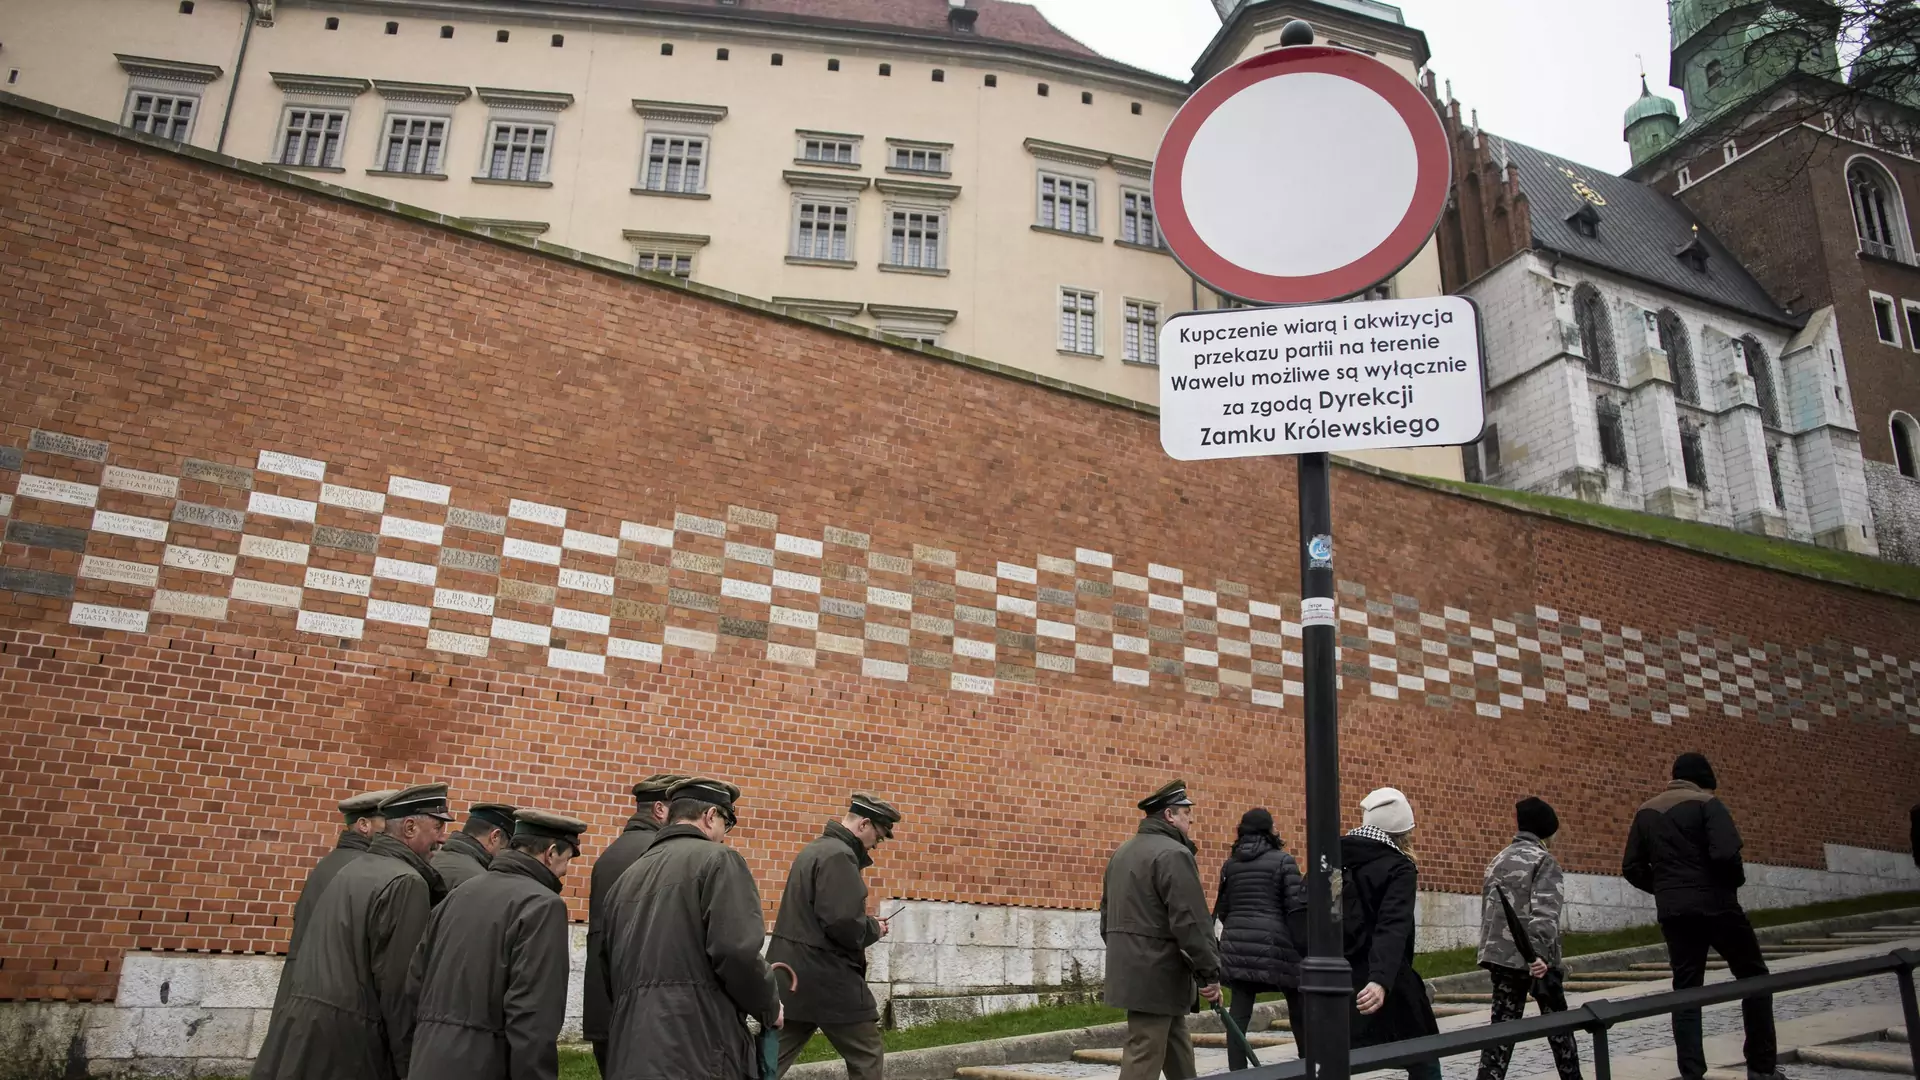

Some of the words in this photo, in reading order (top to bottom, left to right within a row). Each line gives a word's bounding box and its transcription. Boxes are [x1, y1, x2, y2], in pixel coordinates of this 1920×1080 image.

[1180, 321, 1278, 345] Kupczenie
[1284, 318, 1337, 335] wiarą
[1343, 315, 1348, 331] i
[1354, 308, 1453, 330] akwizycja
[1194, 347, 1278, 369] przekazu
[1285, 340, 1333, 363] partii
[1340, 341, 1364, 355] na
[1370, 333, 1440, 353] terenie
[1171, 371, 1245, 391] Wawelu
[1252, 366, 1330, 386] możliwe
[1336, 366, 1359, 382] są
[1364, 356, 1467, 380] wyłącznie
[1223, 402, 1244, 416] za
[1250, 395, 1312, 417] zgodą
[1319, 384, 1414, 413] Dyrekcji
[1200, 424, 1276, 446] Zamku
[1285, 415, 1440, 441] Królewskiego
